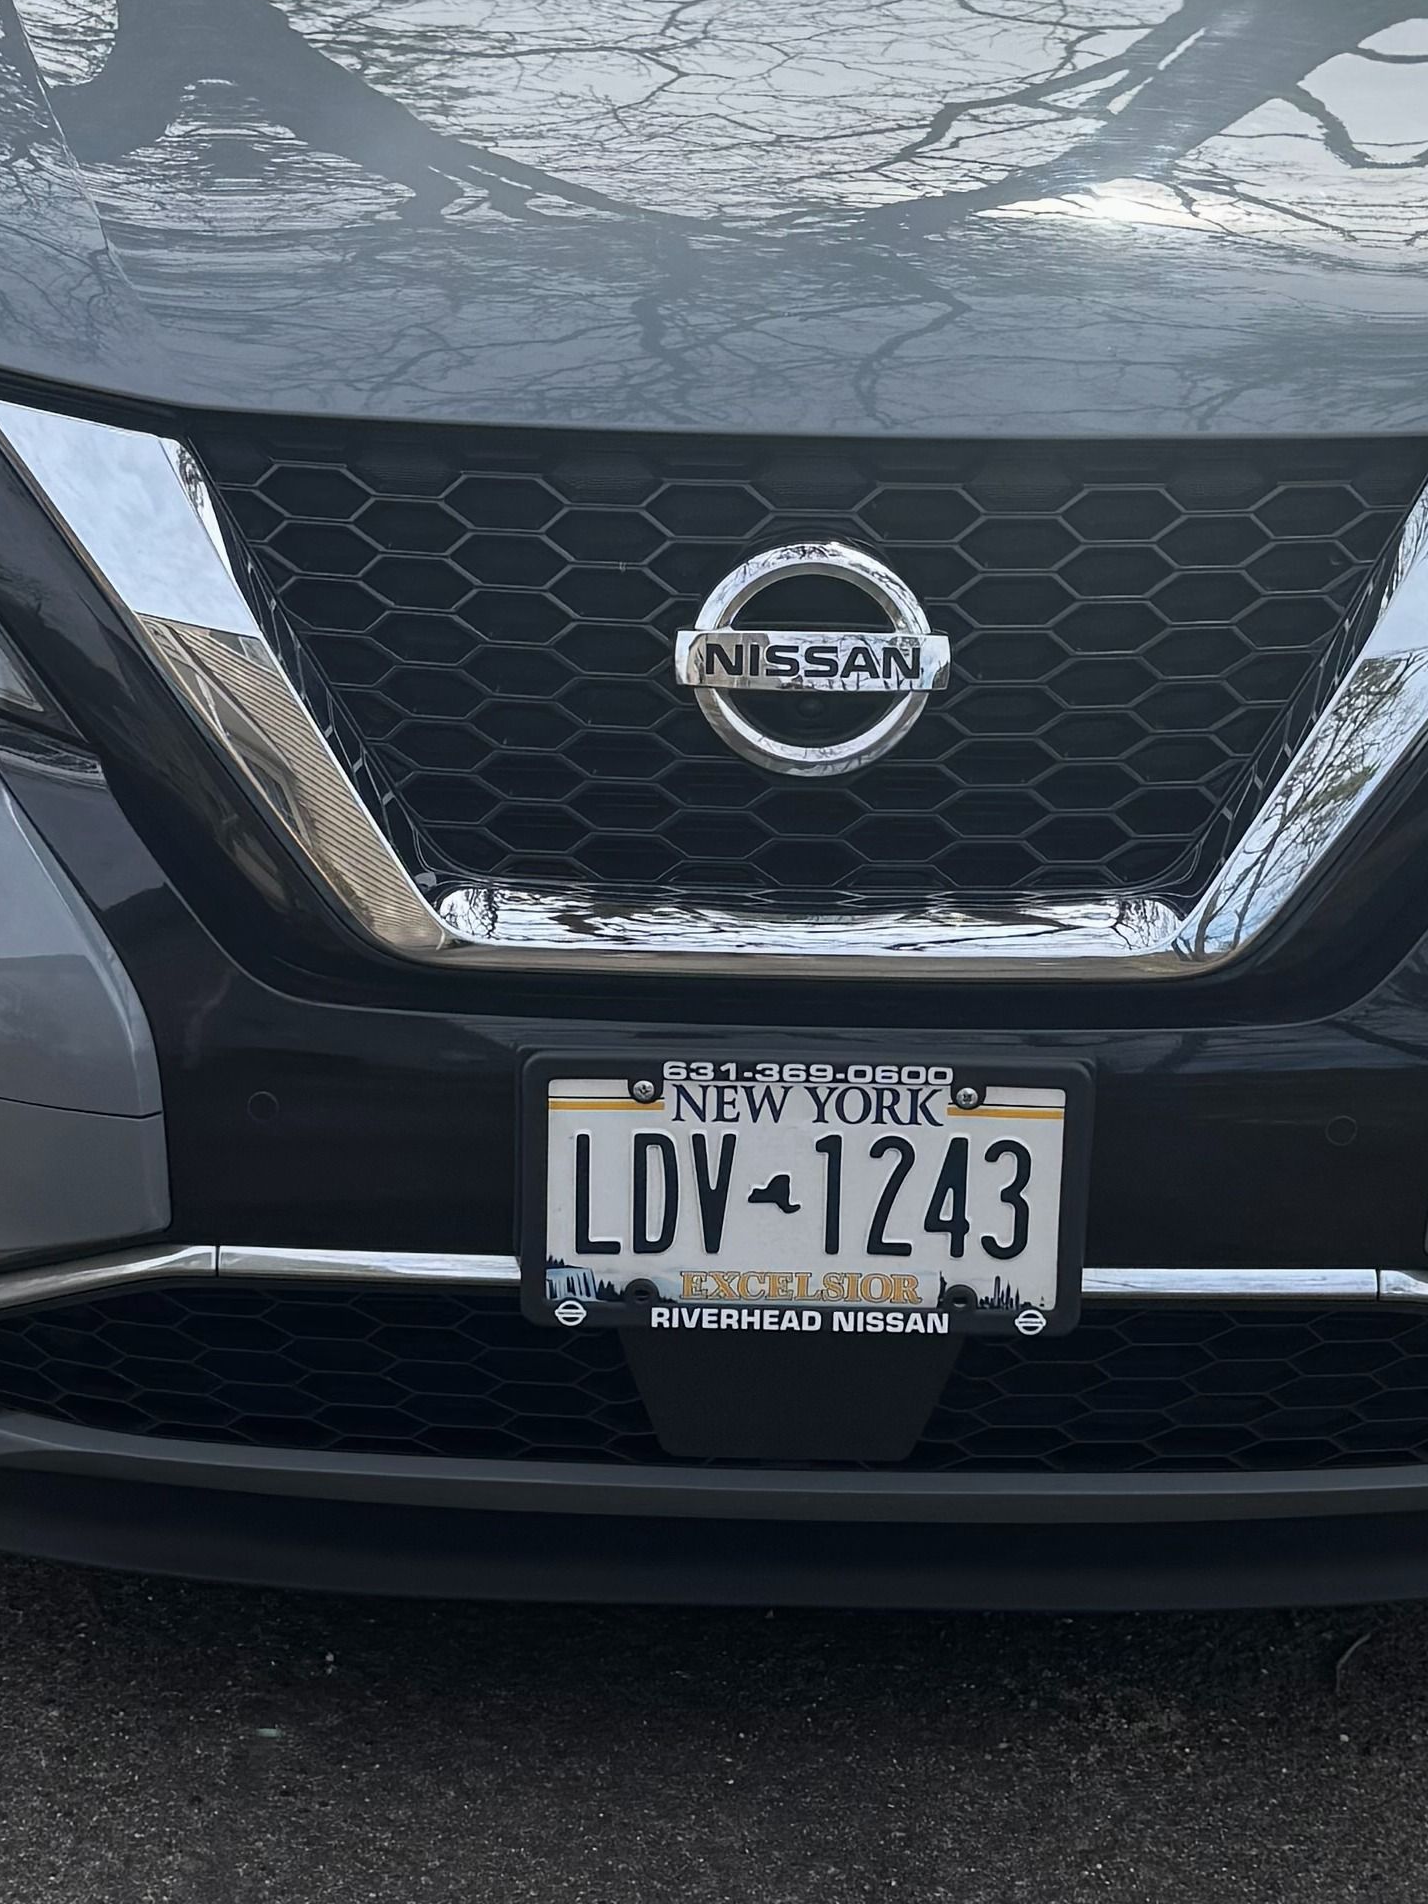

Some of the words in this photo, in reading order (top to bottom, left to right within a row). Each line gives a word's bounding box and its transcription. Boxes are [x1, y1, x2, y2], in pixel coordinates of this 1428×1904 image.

[705, 643, 921, 680] NISSAN
[662, 1060, 954, 1086] 631-369-0600
[671, 1083, 794, 1124] NEW
[803, 1085, 944, 1127] YORK
[574, 1132, 738, 1255] LDV
[813, 1134, 1033, 1260] 1243
[680, 1270, 922, 1305] EXCELSIOR
[651, 1306, 822, 1332] RIVERHEAD
[832, 1310, 949, 1334] NISSAN
